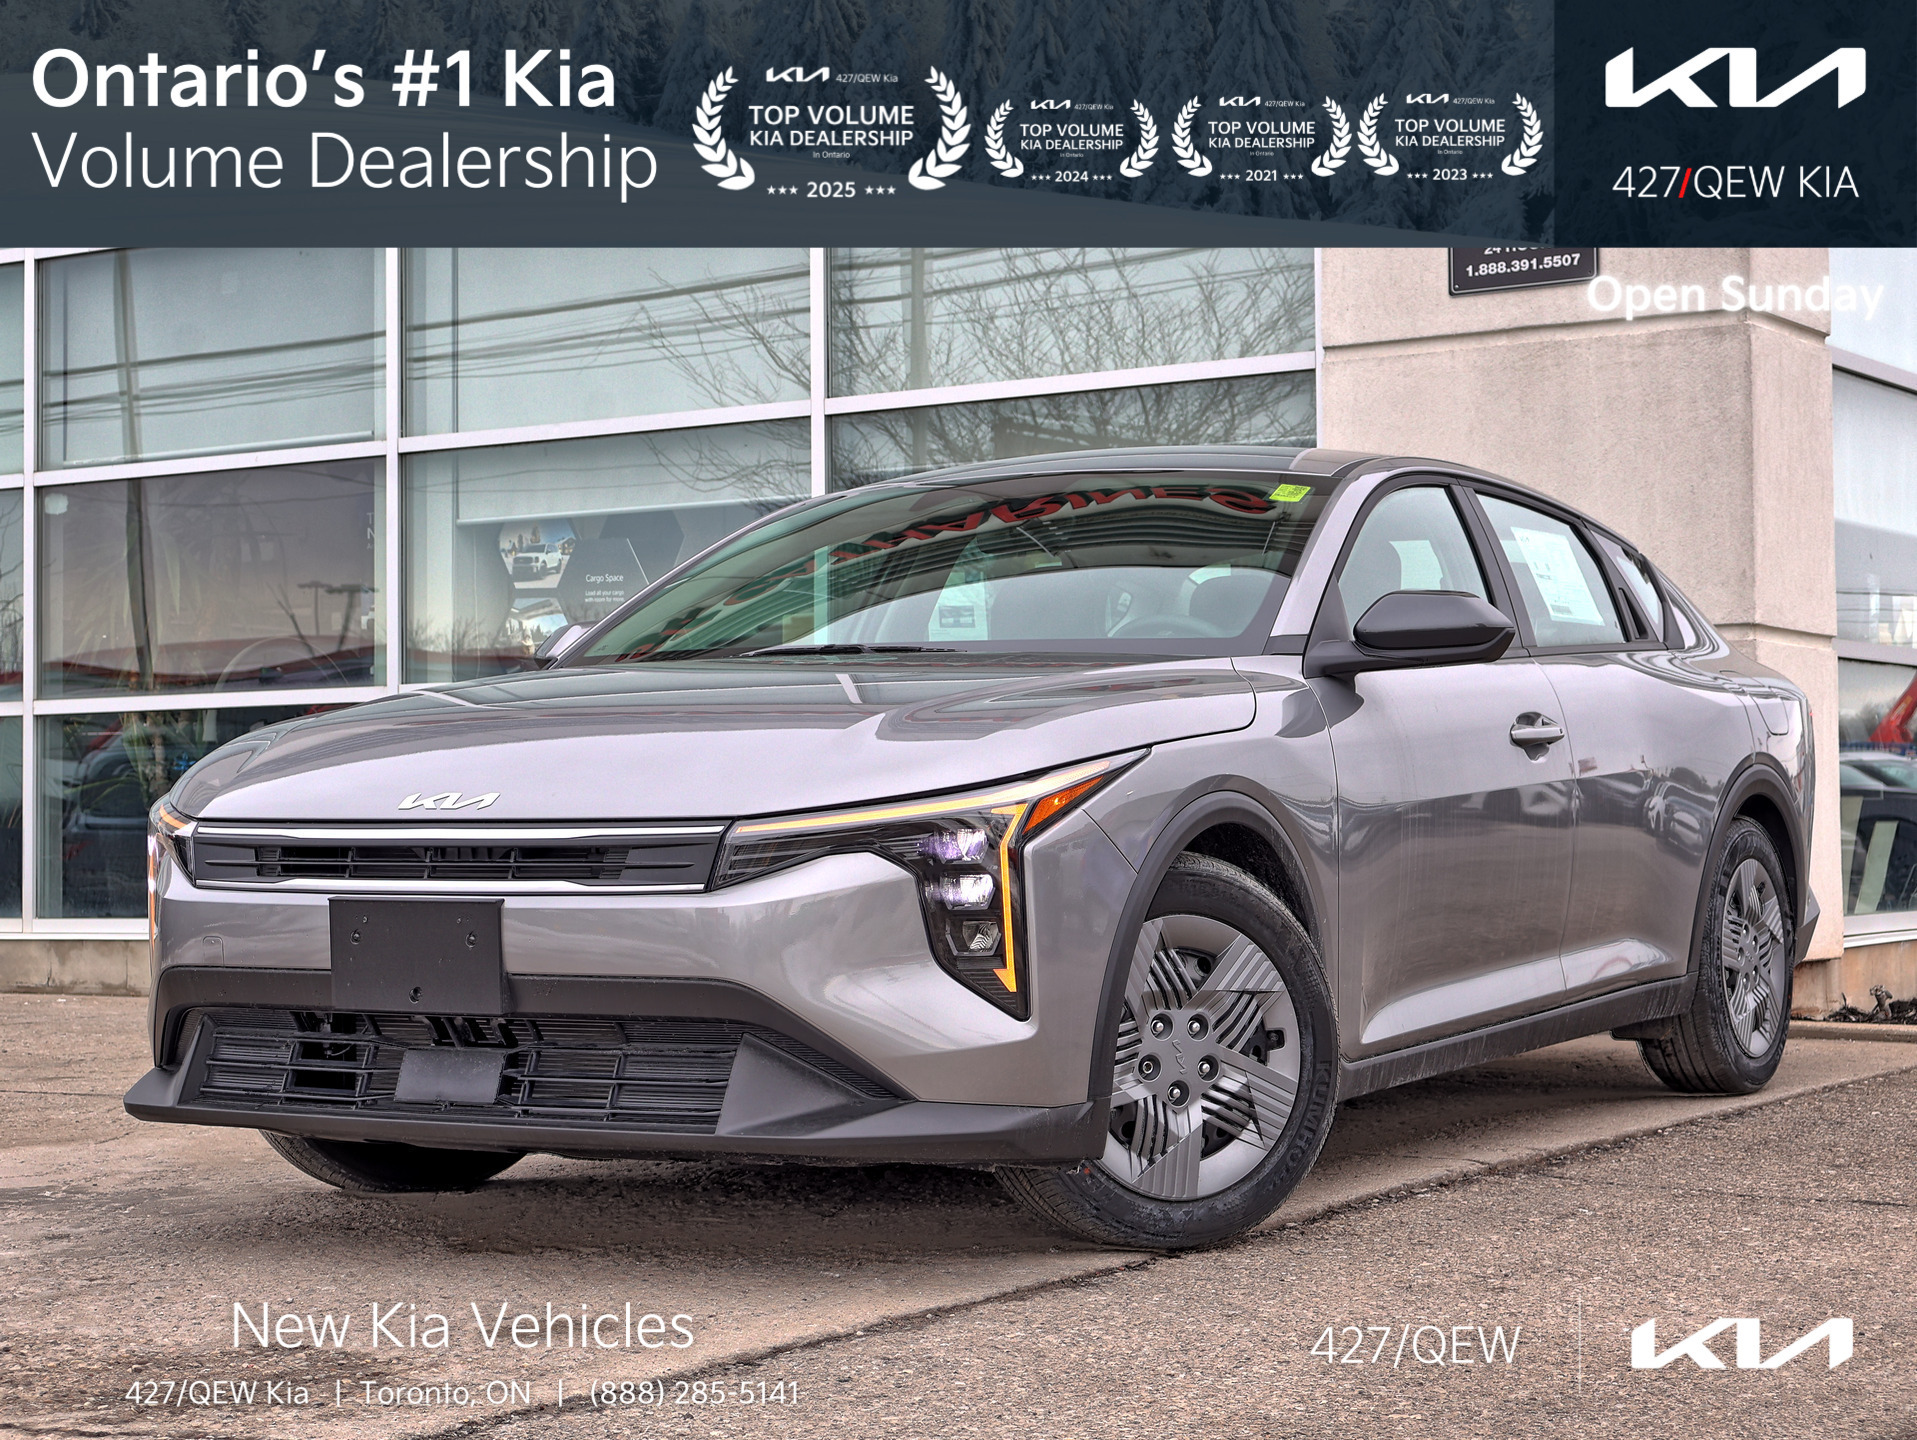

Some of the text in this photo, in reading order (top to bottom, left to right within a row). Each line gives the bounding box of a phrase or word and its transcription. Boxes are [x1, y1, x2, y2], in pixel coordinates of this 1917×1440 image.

[1466, 253, 1581, 277] 1.888.391.5507
[585, 573, 624, 584] Cargo Space
[398, 792, 501, 811] KIA
[1287, 1060, 1333, 1165] KUMHO
